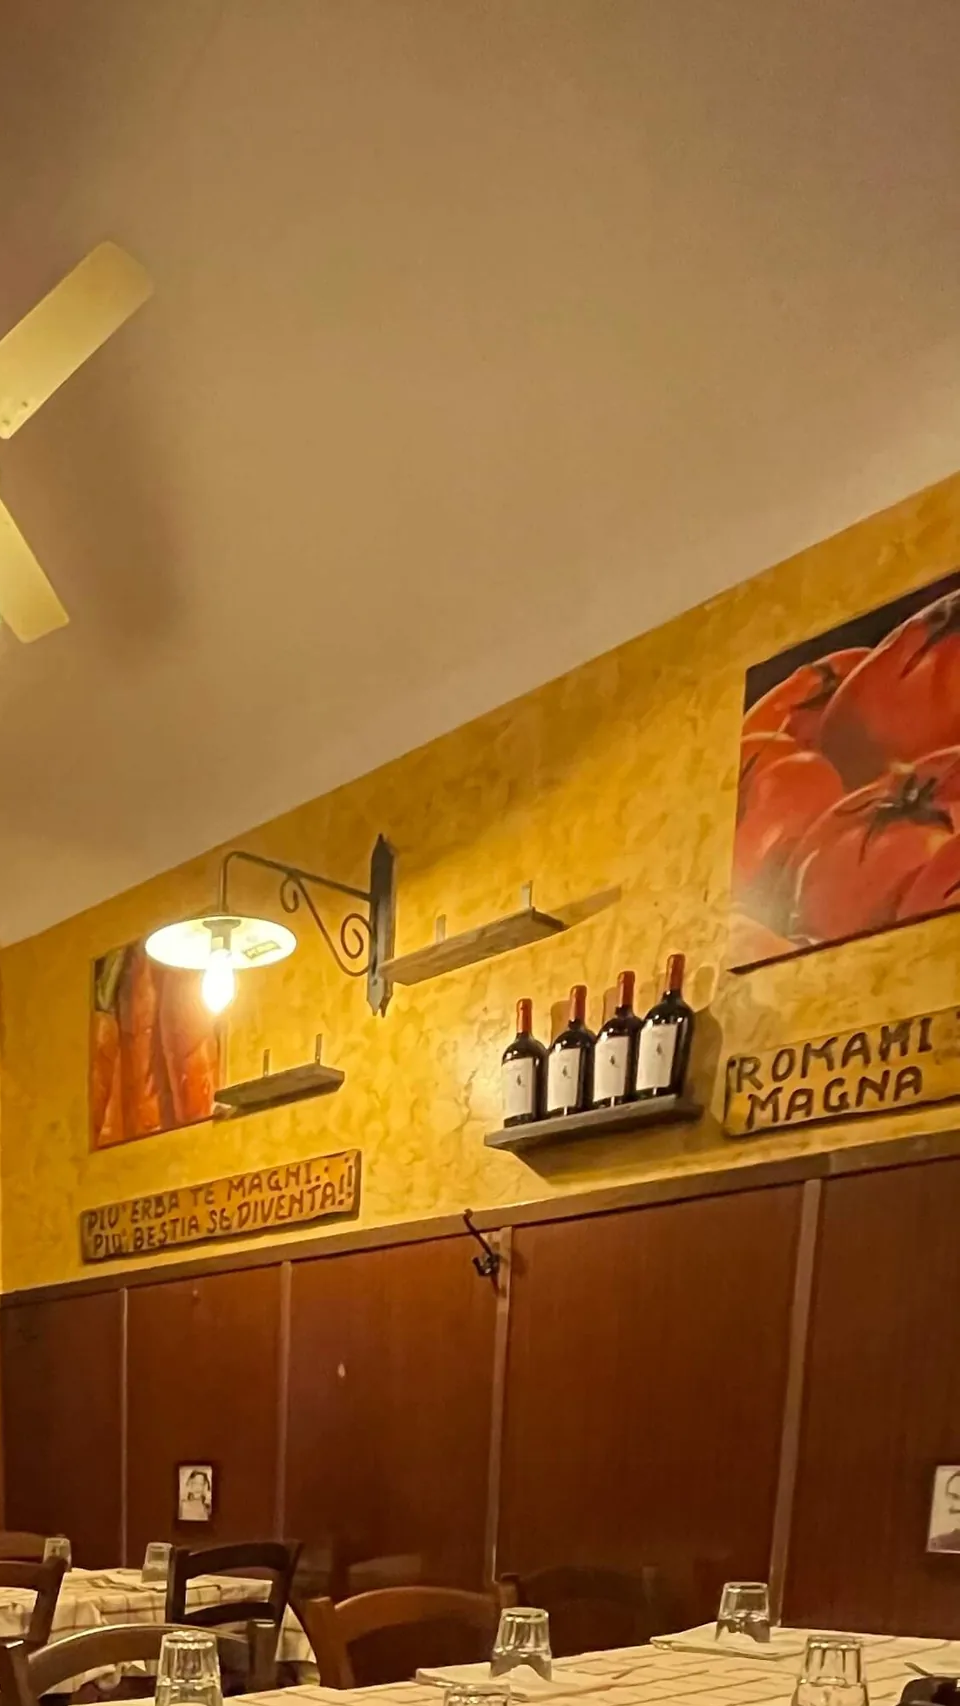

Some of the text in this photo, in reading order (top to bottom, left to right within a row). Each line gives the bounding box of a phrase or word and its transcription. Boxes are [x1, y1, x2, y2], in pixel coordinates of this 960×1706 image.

[745, 1066, 923, 1130] MAGNA
[130, 1191, 178, 1224] ERBA
[133, 1215, 200, 1250] BESTIA
